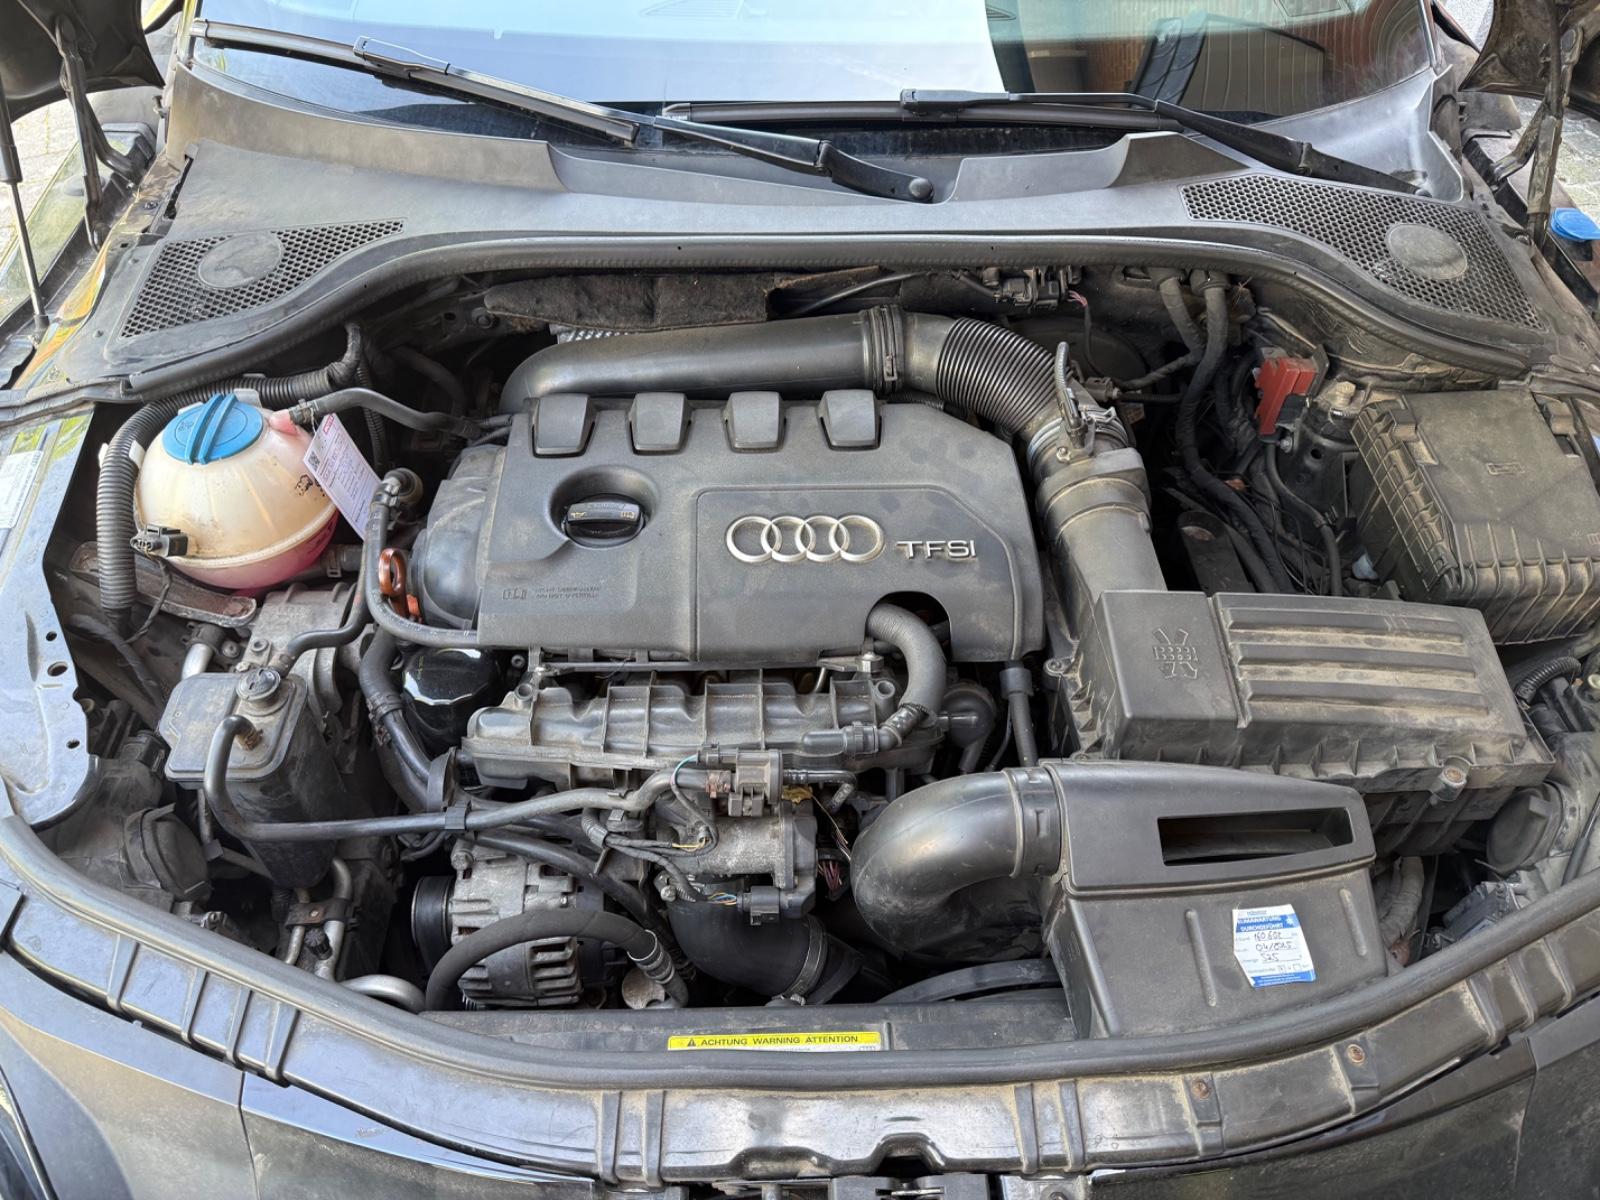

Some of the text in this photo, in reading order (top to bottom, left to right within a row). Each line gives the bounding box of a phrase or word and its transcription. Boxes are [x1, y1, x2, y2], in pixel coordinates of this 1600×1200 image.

[897, 539, 977, 559] TFSI
[701, 1035, 858, 1046] ACHTUNG WARNING ATTENTION
